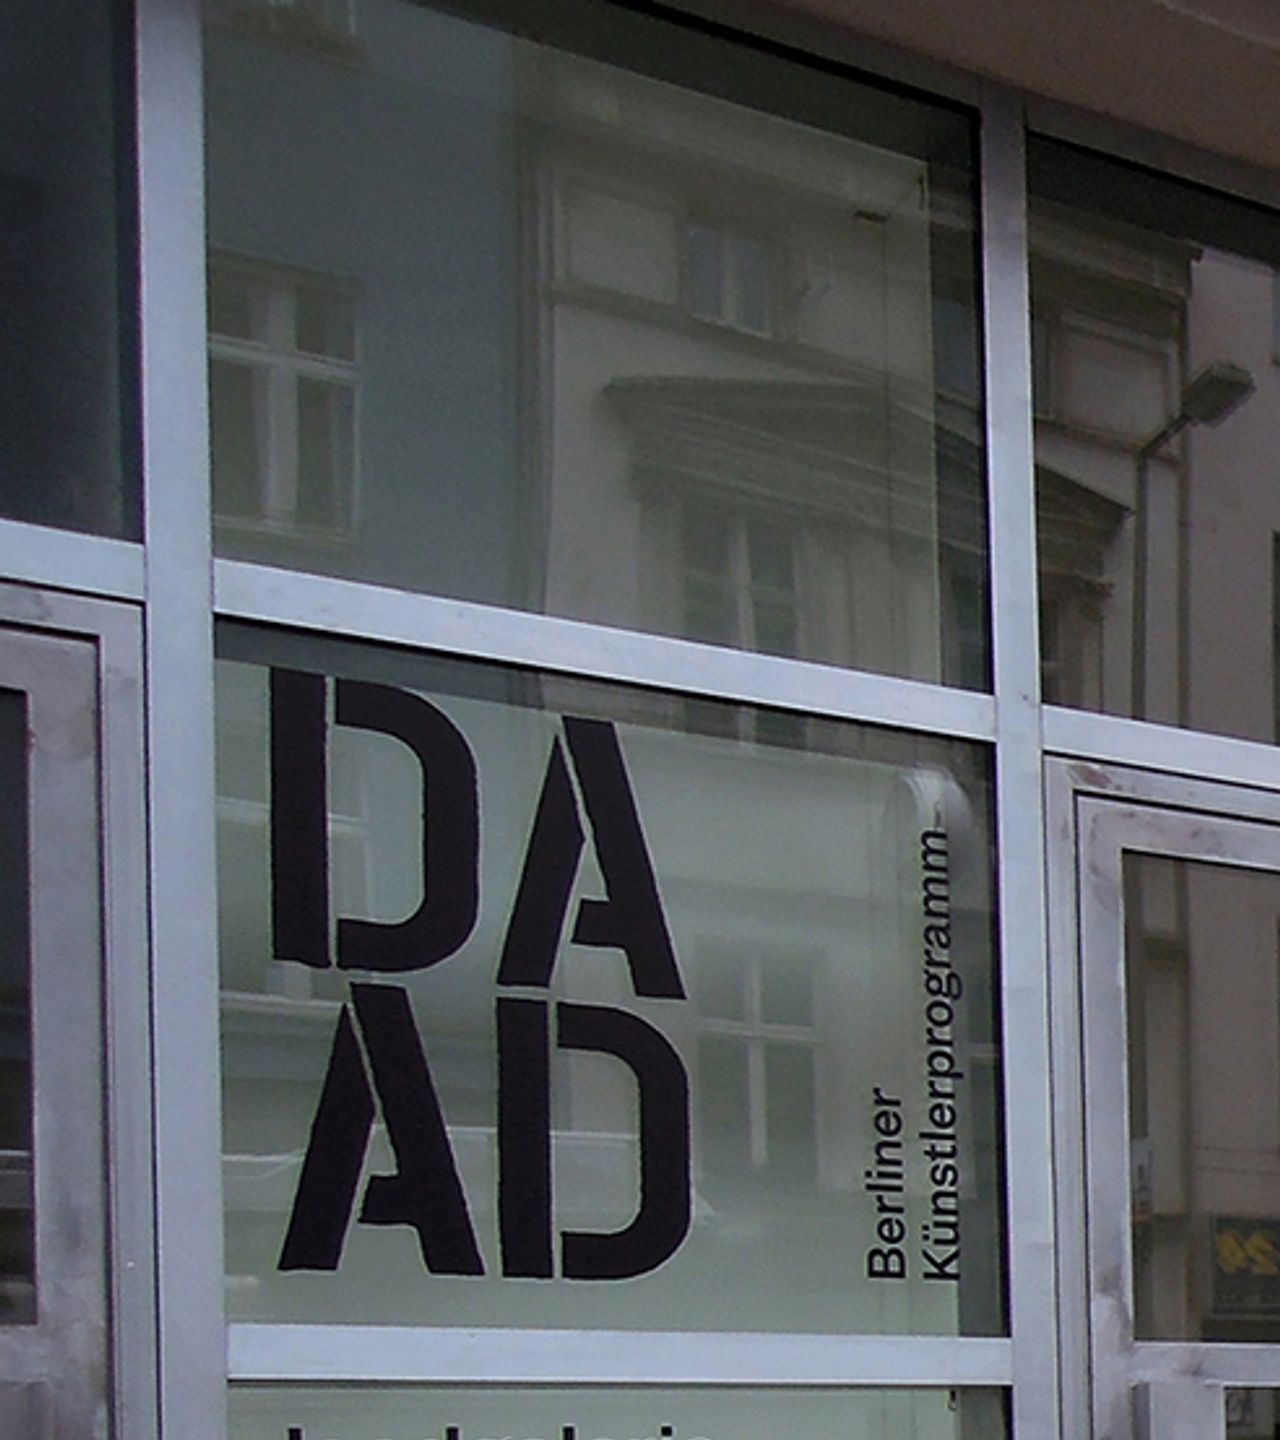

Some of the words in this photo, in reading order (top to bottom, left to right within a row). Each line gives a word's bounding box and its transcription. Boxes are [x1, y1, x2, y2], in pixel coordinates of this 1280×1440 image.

[270, 666, 687, 999] DA
[278, 982, 693, 1280] AD
[867, 1088, 906, 1280] Berliner
[920, 829, 964, 1282] Künstlerprogramm
